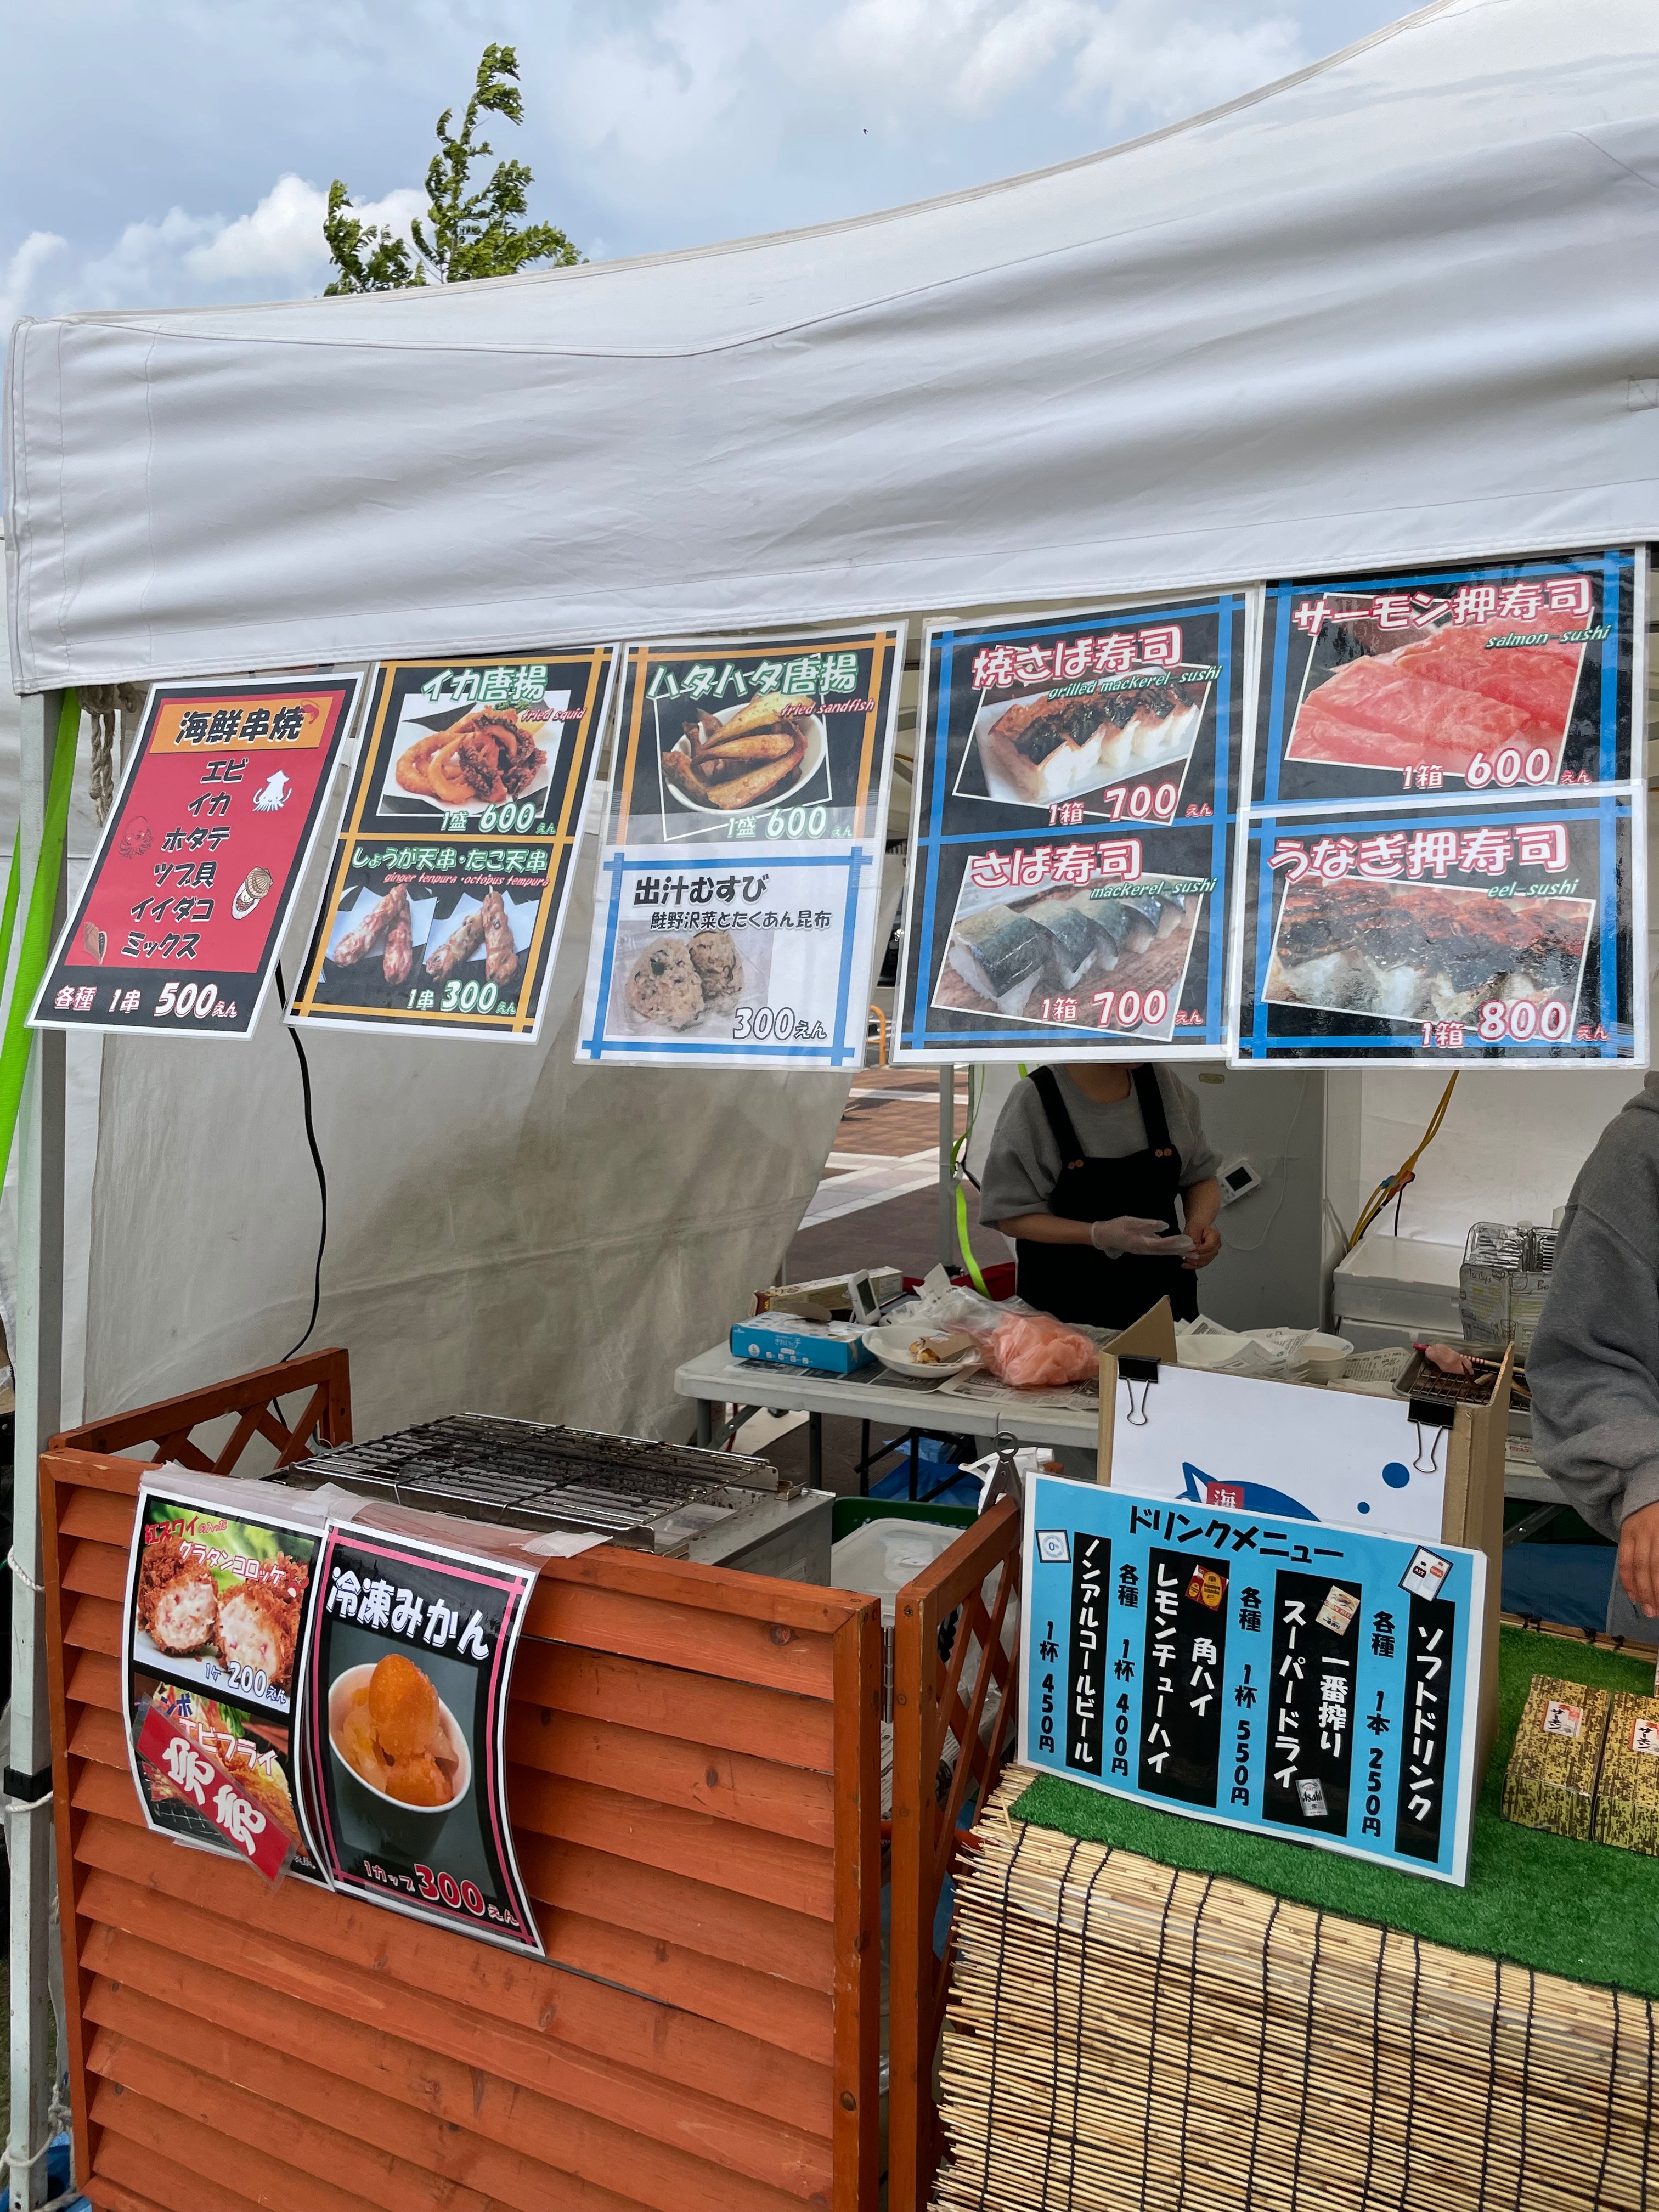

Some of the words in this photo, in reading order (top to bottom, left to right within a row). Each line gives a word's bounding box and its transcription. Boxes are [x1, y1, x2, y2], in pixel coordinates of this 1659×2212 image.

[1292, 577, 1592, 636] サーモン押寿司
[646, 652, 859, 701] ハタハタ唐揚
[972, 625, 1183, 691] 焼さば寿司
[421, 664, 548, 704] イカ唐揚
[1047, 679, 1098, 702] grilled
[174, 704, 305, 746] 海鮮串焼
[521, 709, 554, 723] fried
[551, 707, 588, 723] squid
[781, 703, 816, 717] fried
[817, 698, 875, 715] sandfish
[201, 758, 249, 784] エビ
[1403, 764, 1444, 790] 1箱
[1464, 748, 1551, 788] 600
[1559, 769, 1592, 785] えん
[188, 792, 231, 817] イカ
[441, 811, 467, 832] 1盛
[1048, 803, 1085, 825] 1箱
[1103, 783, 1180, 821] 700
[1185, 803, 1214, 819] えん
[161, 826, 230, 853] ホタテ
[727, 816, 757, 839] 1盛
[352, 846, 548, 873] しょうが天串・たこ天串
[971, 838, 1143, 888] さば寿司
[1267, 823, 1570, 882] うなぎ押寿司
[154, 861, 218, 888] ツブ貝
[384, 872, 417, 884] ginger
[634, 873, 769, 906] 出汁むすび
[131, 898, 215, 923] イイダコ
[651, 910, 833, 930] 鮭野沢菜とたくあん昆布
[121, 931, 201, 959] ミックス
[55, 986, 97, 1011] 各種
[109, 989, 141, 1014] 1串
[407, 988, 435, 1011] 1串
[1041, 998, 1077, 1021] 1箱
[1092, 990, 1168, 1027] 700
[1175, 1010, 1203, 1025] えん
[1421, 1022, 1464, 1048] 1箱
[1477, 1000, 1570, 1043] 800
[1576, 1025, 1609, 1042] えん
[1128, 1505, 1344, 1564] ドリンクメニュー
[179, 1541, 286, 1587] グラタンコロッケ
[1117, 1564, 1139, 1609] 各種
[327, 1566, 489, 1661] 冷凍みかん
[1239, 1587, 1262, 1633] 各種
[1039, 1621, 1059, 1663] 1杯
[1074, 1539, 1099, 1763] ノンアルコールビール
[1371, 1611, 1396, 1658] 各種
[1114, 1639, 1135, 1682] 1杯
[1148, 1563, 1178, 1774] レモンチューハイ
[1190, 1637, 1217, 1717] 角ハイ
[1234, 1664, 1257, 1709] 1杯
[1273, 1600, 1306, 1788] スーパードライ
[1319, 1656, 1350, 1757] 一番搾り
[1367, 1691, 1390, 1735] 1本
[1407, 1624, 1444, 1822] ソフトドリンク
